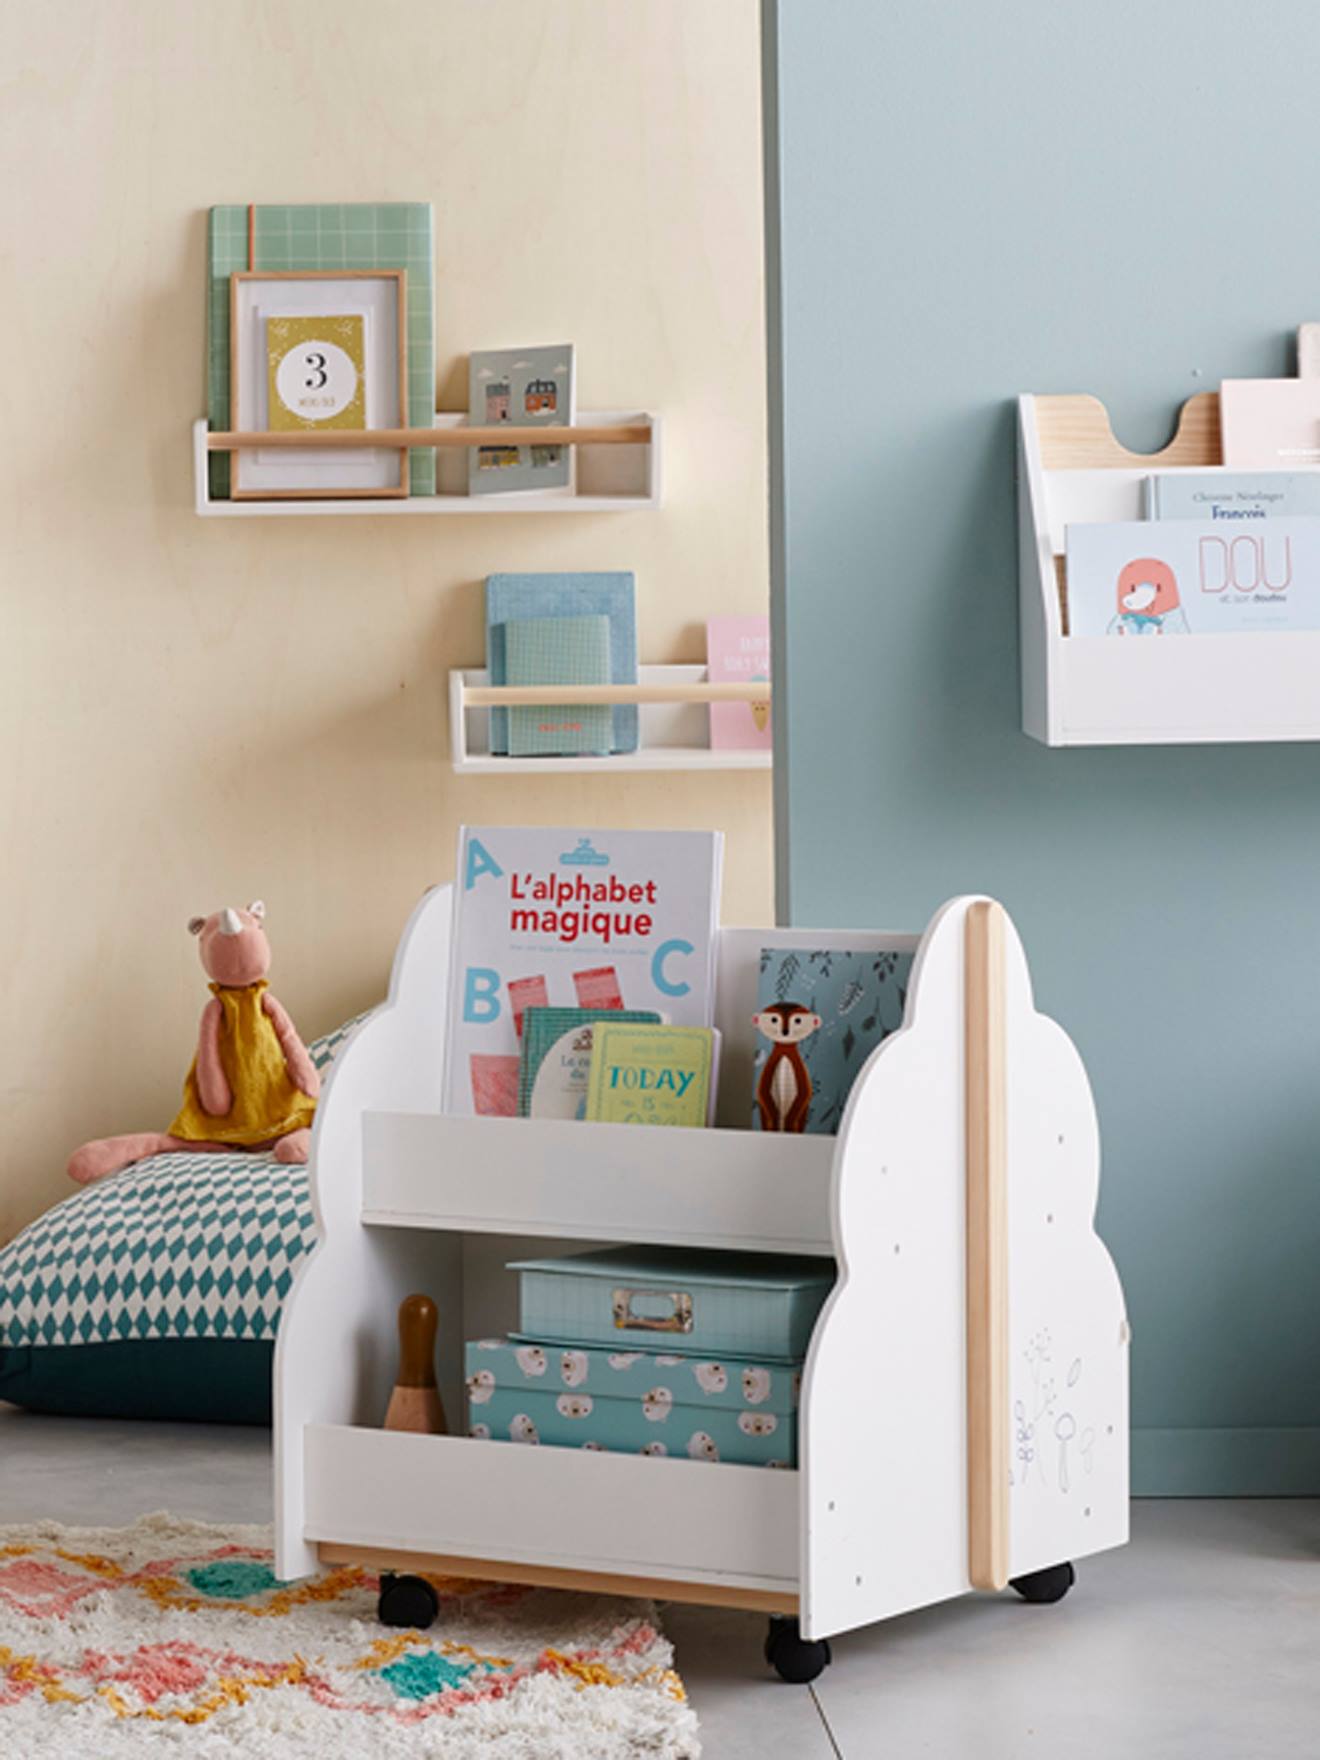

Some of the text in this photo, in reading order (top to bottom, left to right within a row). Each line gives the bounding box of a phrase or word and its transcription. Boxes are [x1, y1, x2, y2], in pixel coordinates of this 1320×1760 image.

[305, 353, 327, 391] 3
[1199, 535, 1293, 594] DOU
[464, 838, 504, 891] A
[510, 873, 657, 908] L'alphabet
[510, 904, 653, 943] magique
[651, 939, 695, 997] C
[463, 967, 501, 1024] B
[608, 1066, 696, 1097] TODAY
